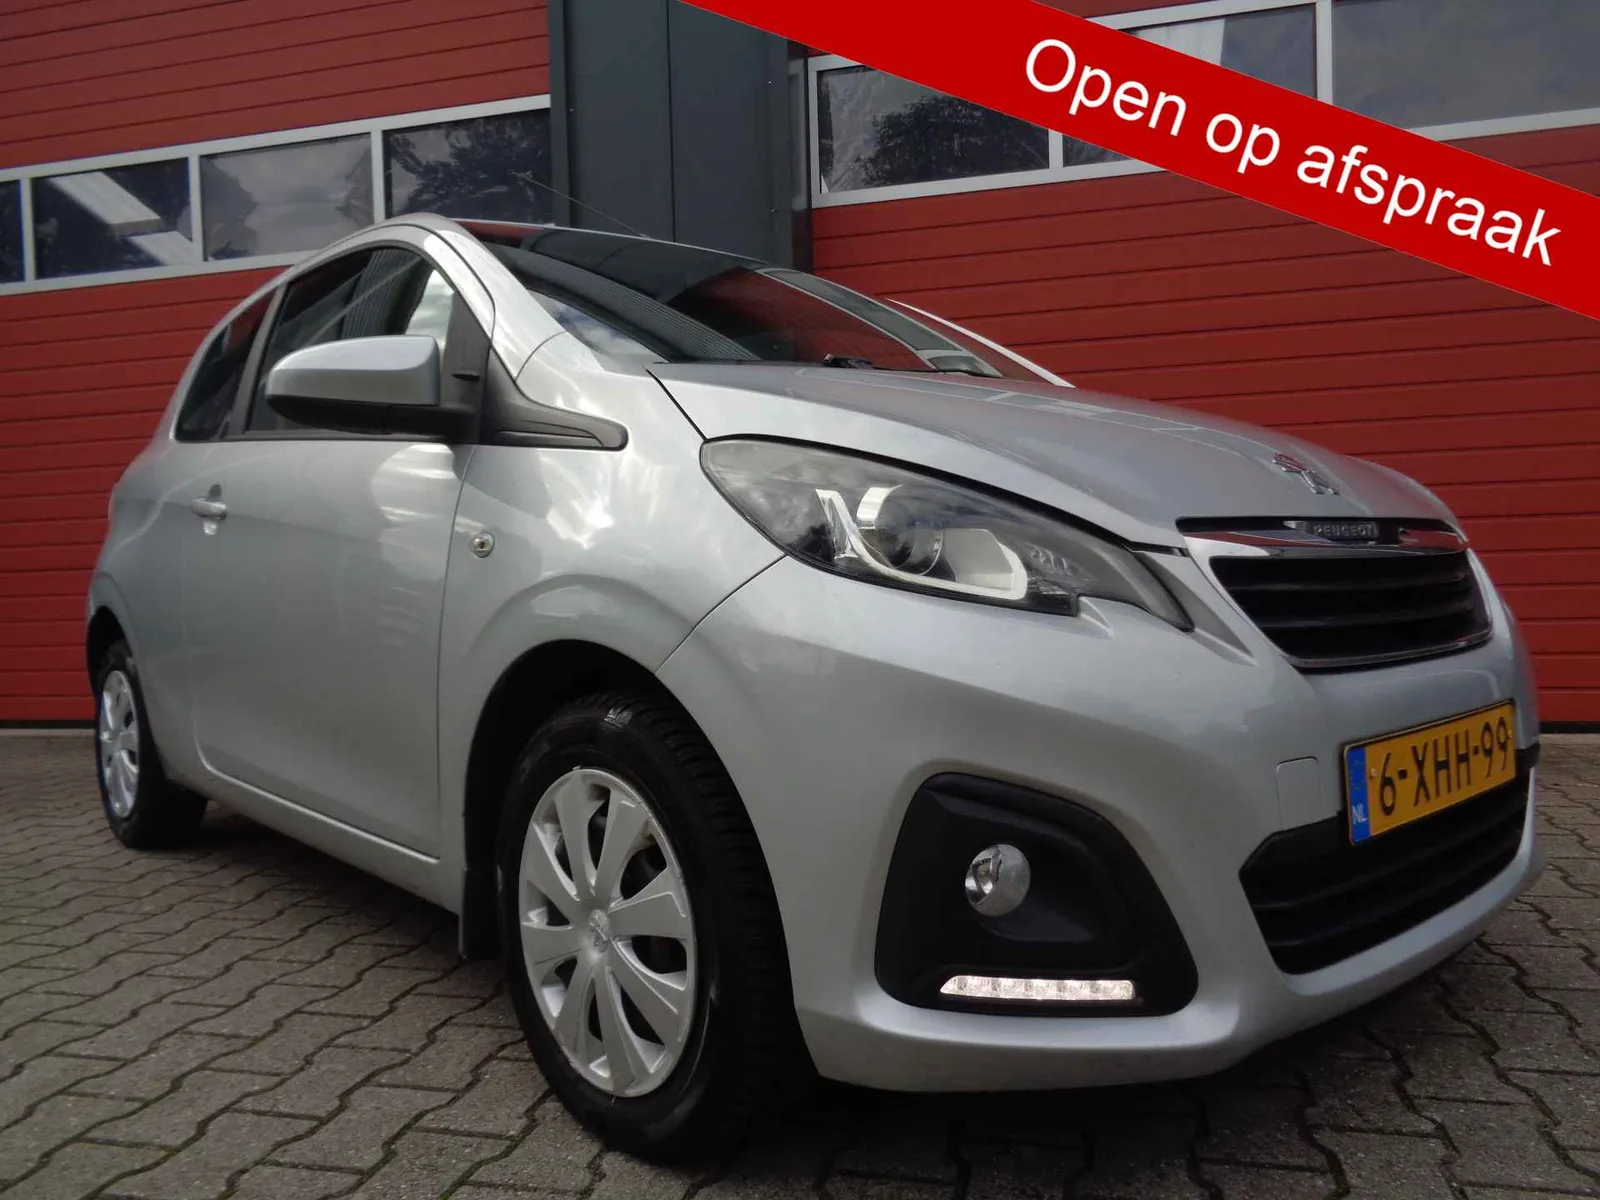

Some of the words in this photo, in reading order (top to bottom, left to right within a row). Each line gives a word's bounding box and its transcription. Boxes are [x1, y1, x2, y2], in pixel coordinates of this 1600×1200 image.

[1313, 523, 1374, 537] PEUGEOT
[1380, 717, 1509, 815] 6-XHH-99
[1351, 803, 1368, 825] NL
